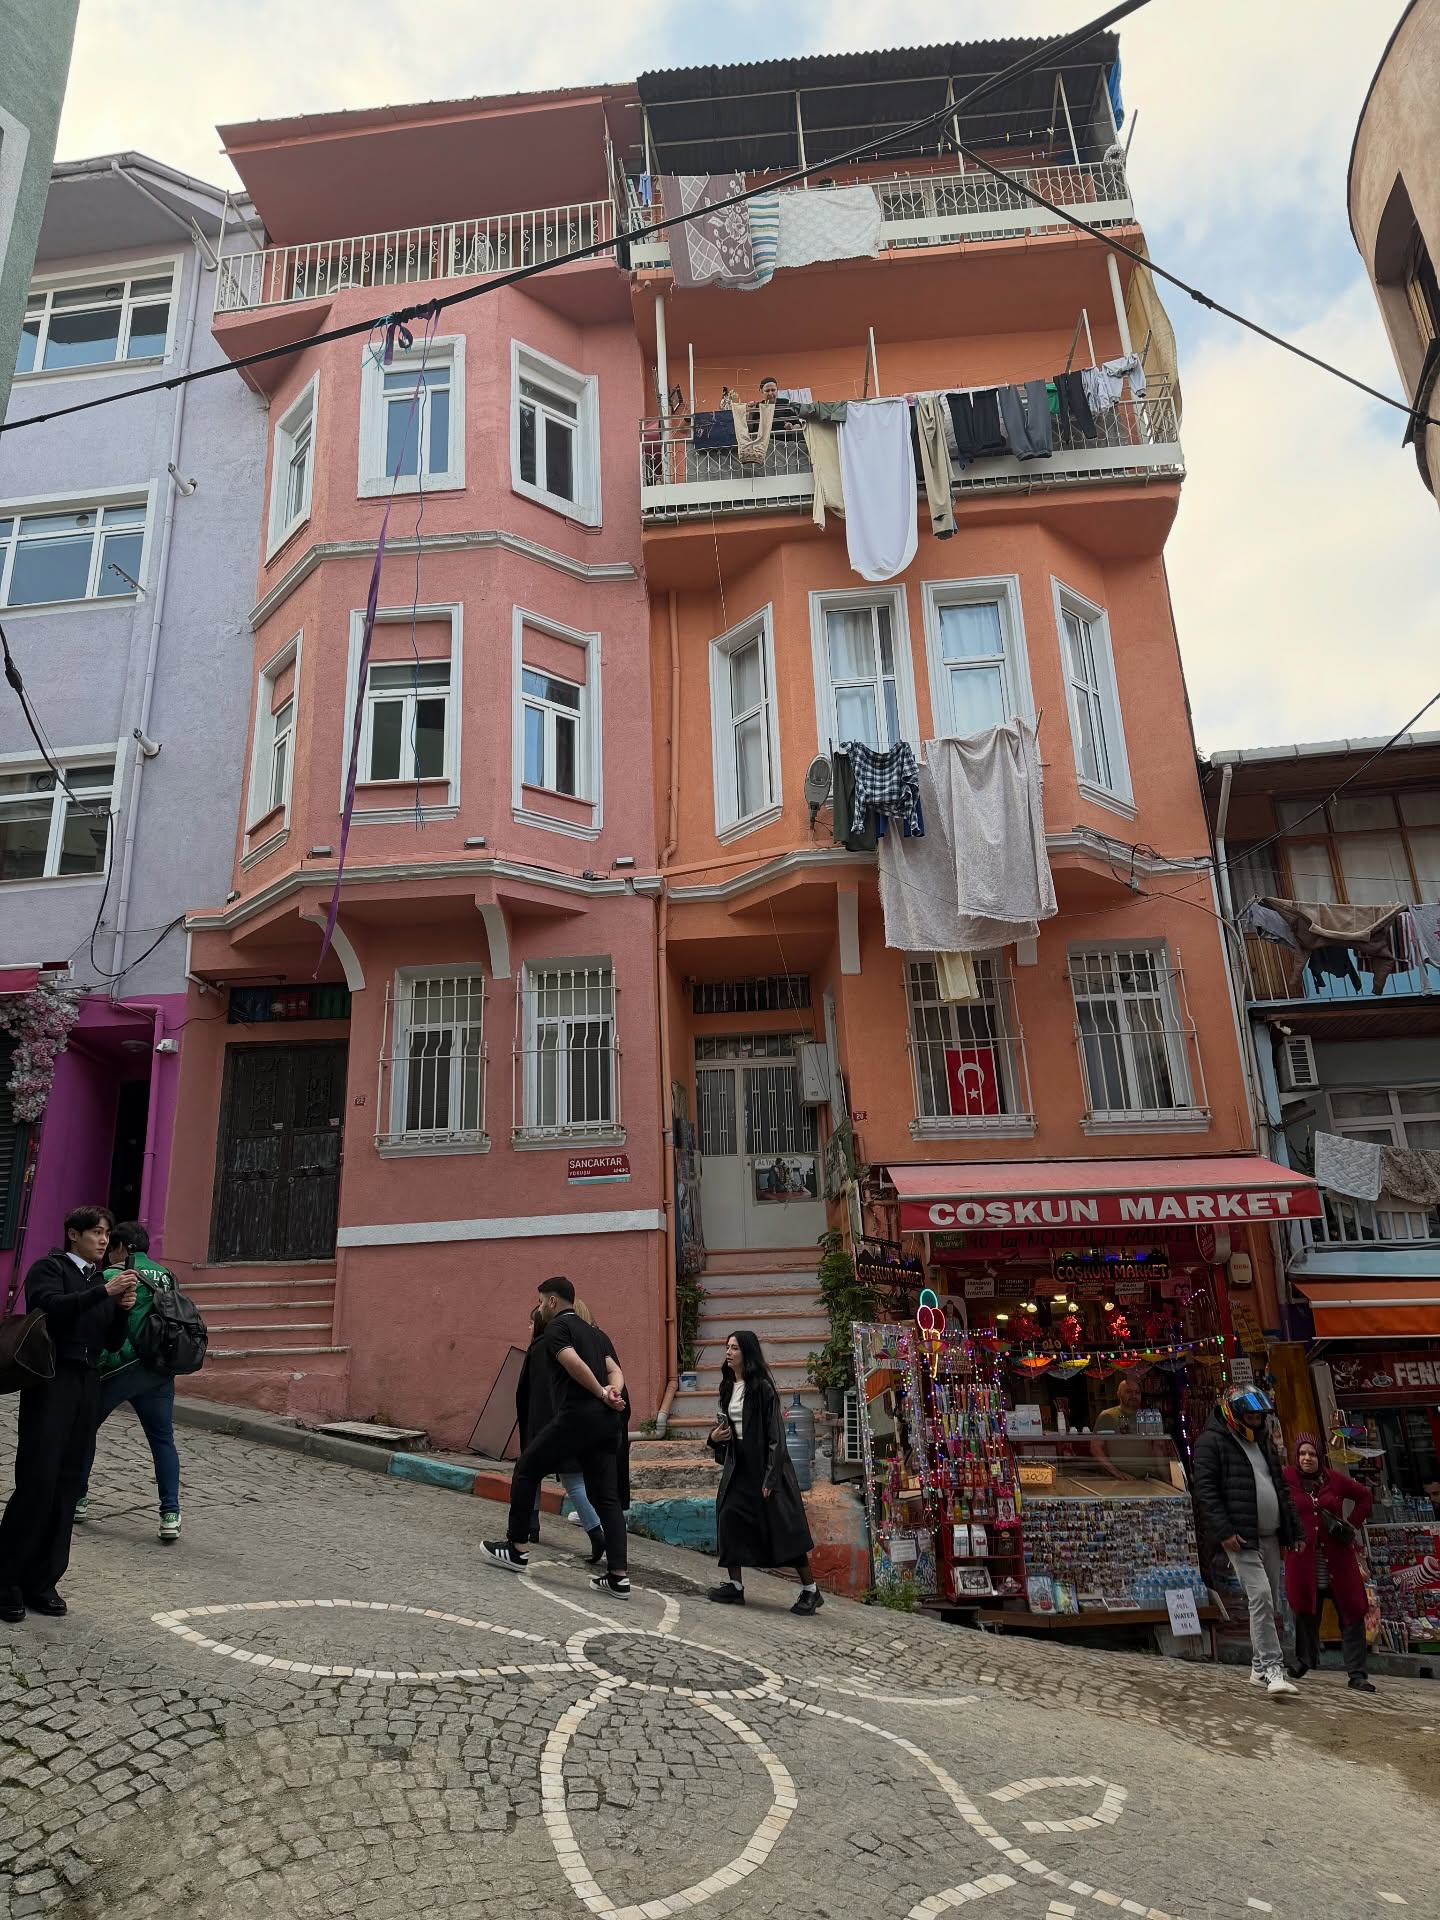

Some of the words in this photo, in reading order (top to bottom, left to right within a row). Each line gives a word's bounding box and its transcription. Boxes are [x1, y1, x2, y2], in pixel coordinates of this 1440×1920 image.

[569, 1157, 623, 1169] SANCAKTAR
[1119, 1192, 1293, 1221] MARKET
[895, 1268, 924, 1286] MARKET
[1114, 1263, 1168, 1279] MARKET
[1173, 1612, 1195, 1620] WATER
